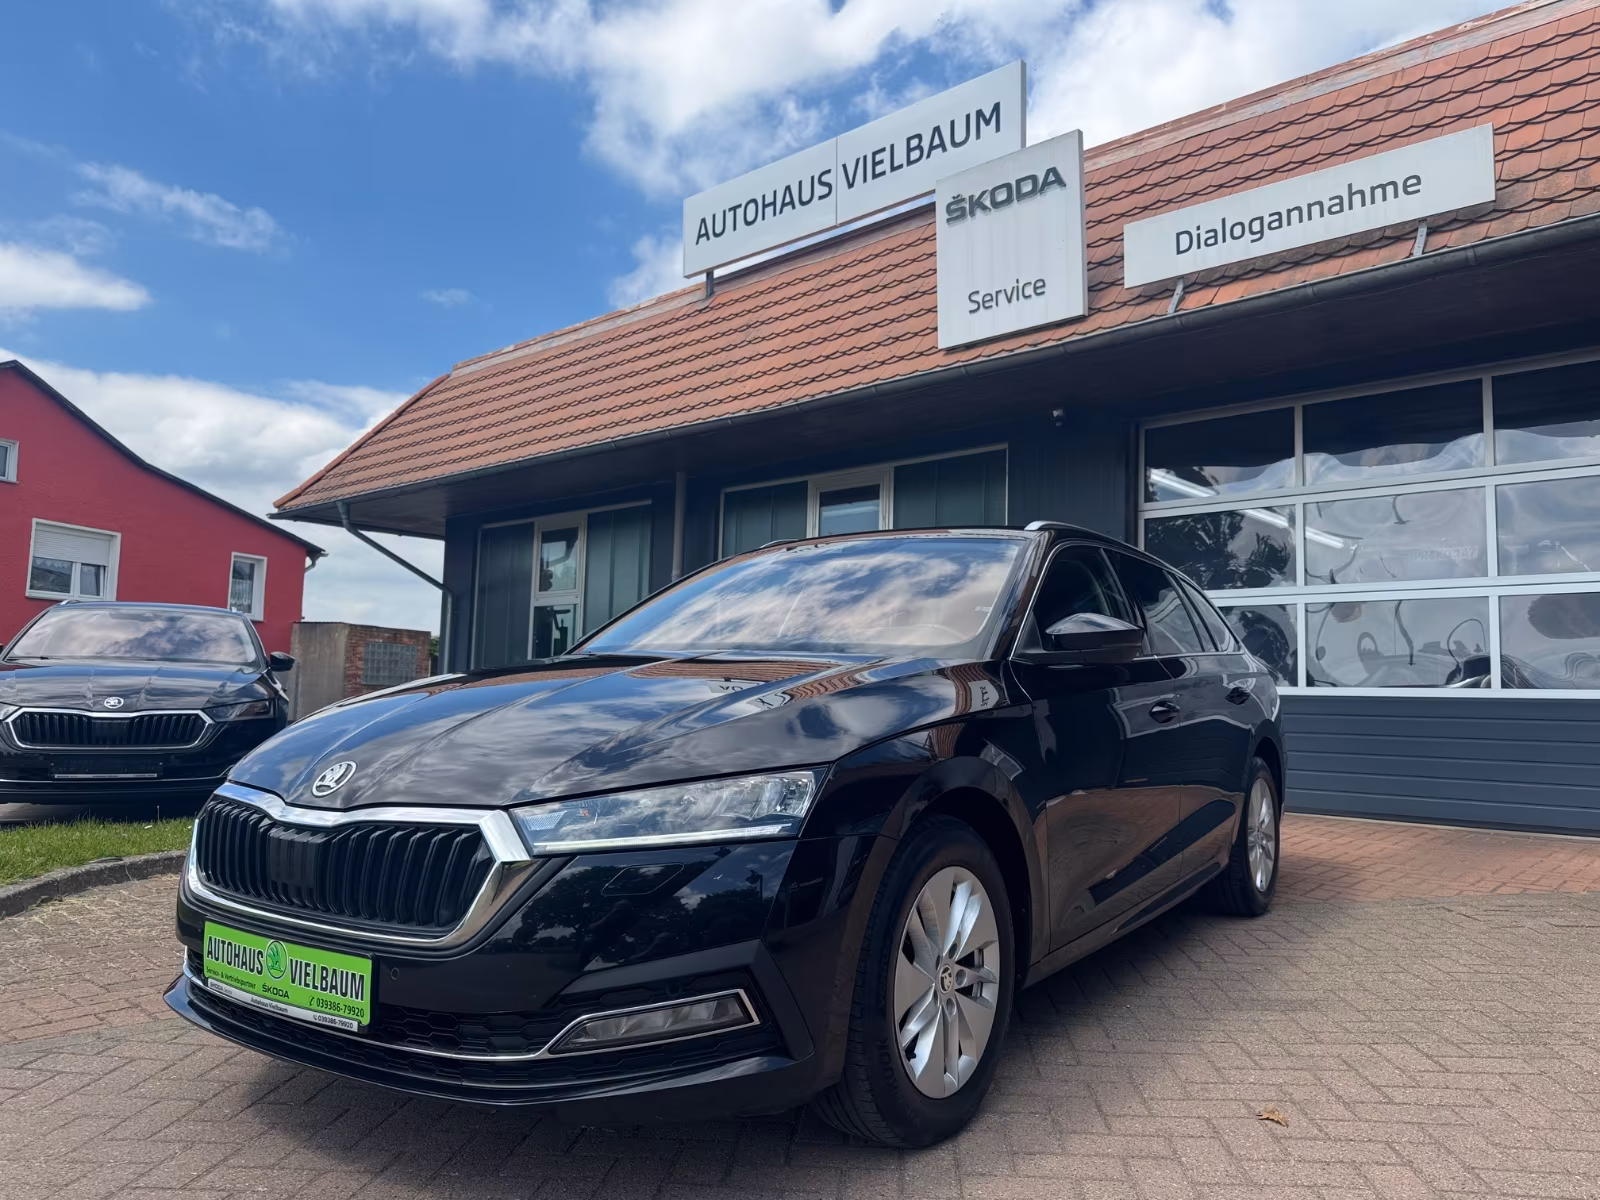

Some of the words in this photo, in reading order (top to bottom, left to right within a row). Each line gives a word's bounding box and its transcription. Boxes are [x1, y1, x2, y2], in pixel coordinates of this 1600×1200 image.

[695, 168, 834, 246] AUTOHAUS
[841, 100, 1002, 190] VIELBAUM
[945, 166, 1067, 226] ŠKODA
[1175, 174, 1422, 256] Dialogannahme
[967, 275, 1046, 315] Service
[206, 935, 264, 976] AUTOHAUS
[289, 957, 365, 1002] VIELBAUM
[261, 982, 290, 1000] ŠKODA
[316, 997, 365, 1018] 039386-79920
[318, 1014, 354, 1029] 039386-79920
